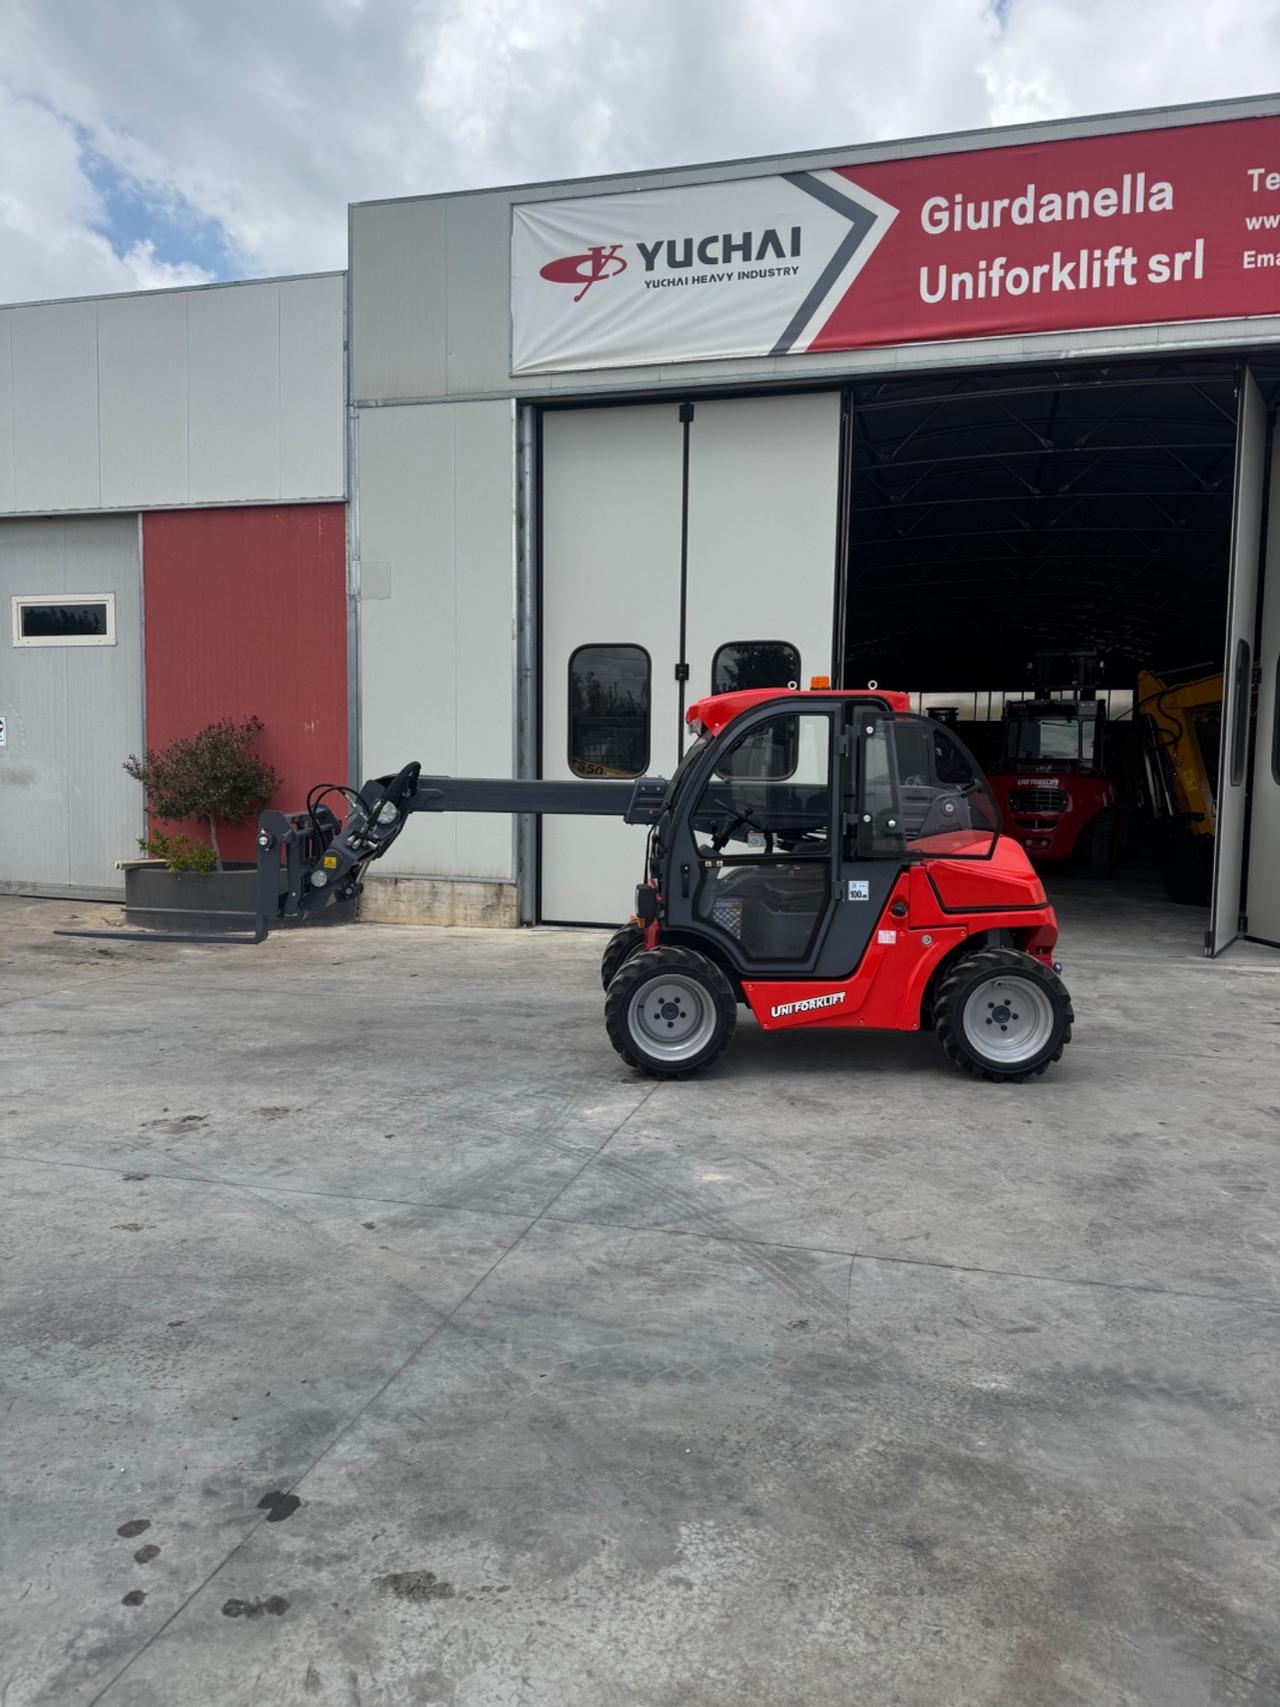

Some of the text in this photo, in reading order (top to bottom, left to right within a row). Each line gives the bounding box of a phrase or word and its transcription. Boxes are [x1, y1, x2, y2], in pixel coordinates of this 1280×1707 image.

[920, 172, 1174, 235] Giurdanella
[636, 226, 801, 272] YUCHAI
[919, 238, 1205, 304] Uniforklift srl
[644, 265, 800, 289] YUCHAI HEAVY INDUSTRY
